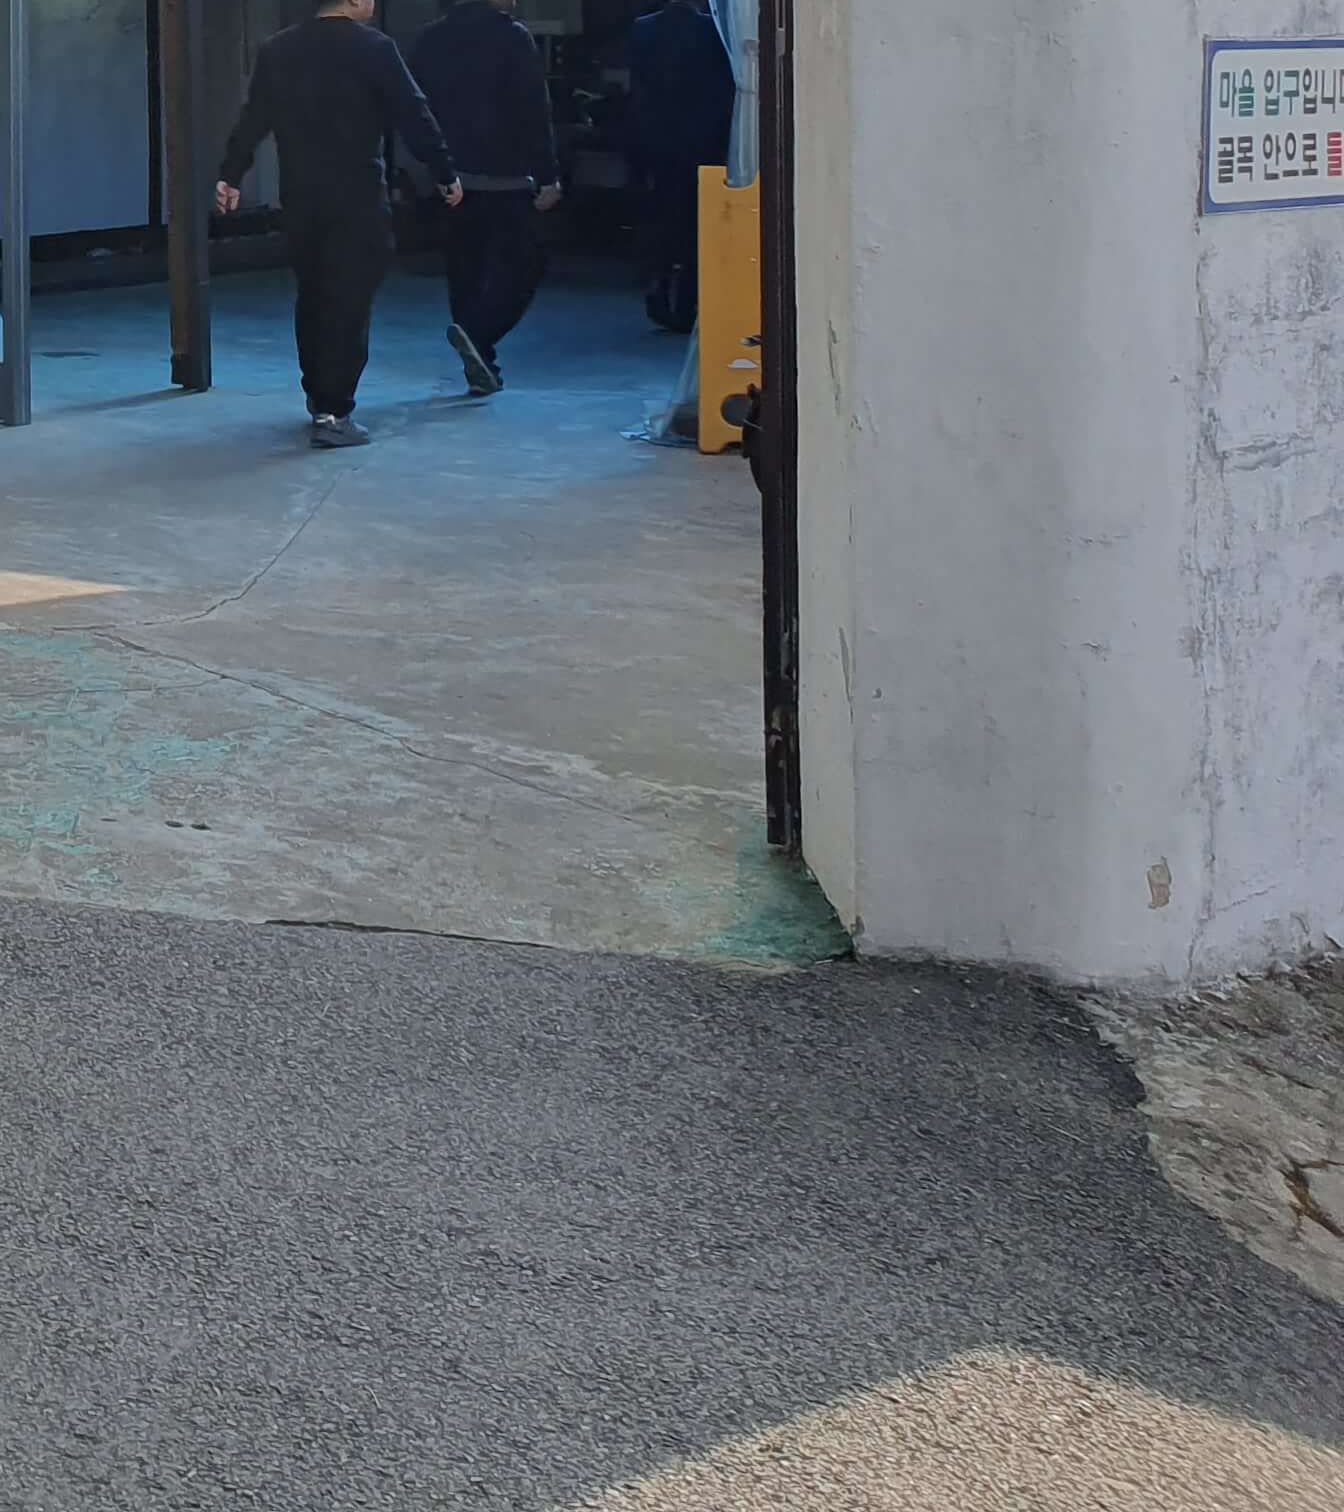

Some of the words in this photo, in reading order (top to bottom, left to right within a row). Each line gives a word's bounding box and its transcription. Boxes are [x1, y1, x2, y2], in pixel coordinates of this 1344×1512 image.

[1219, 68, 1255, 118] 마을
[1263, 67, 1344, 116] 입구입니
[1217, 136, 1254, 184] 골목
[1263, 132, 1319, 181] 안으로
